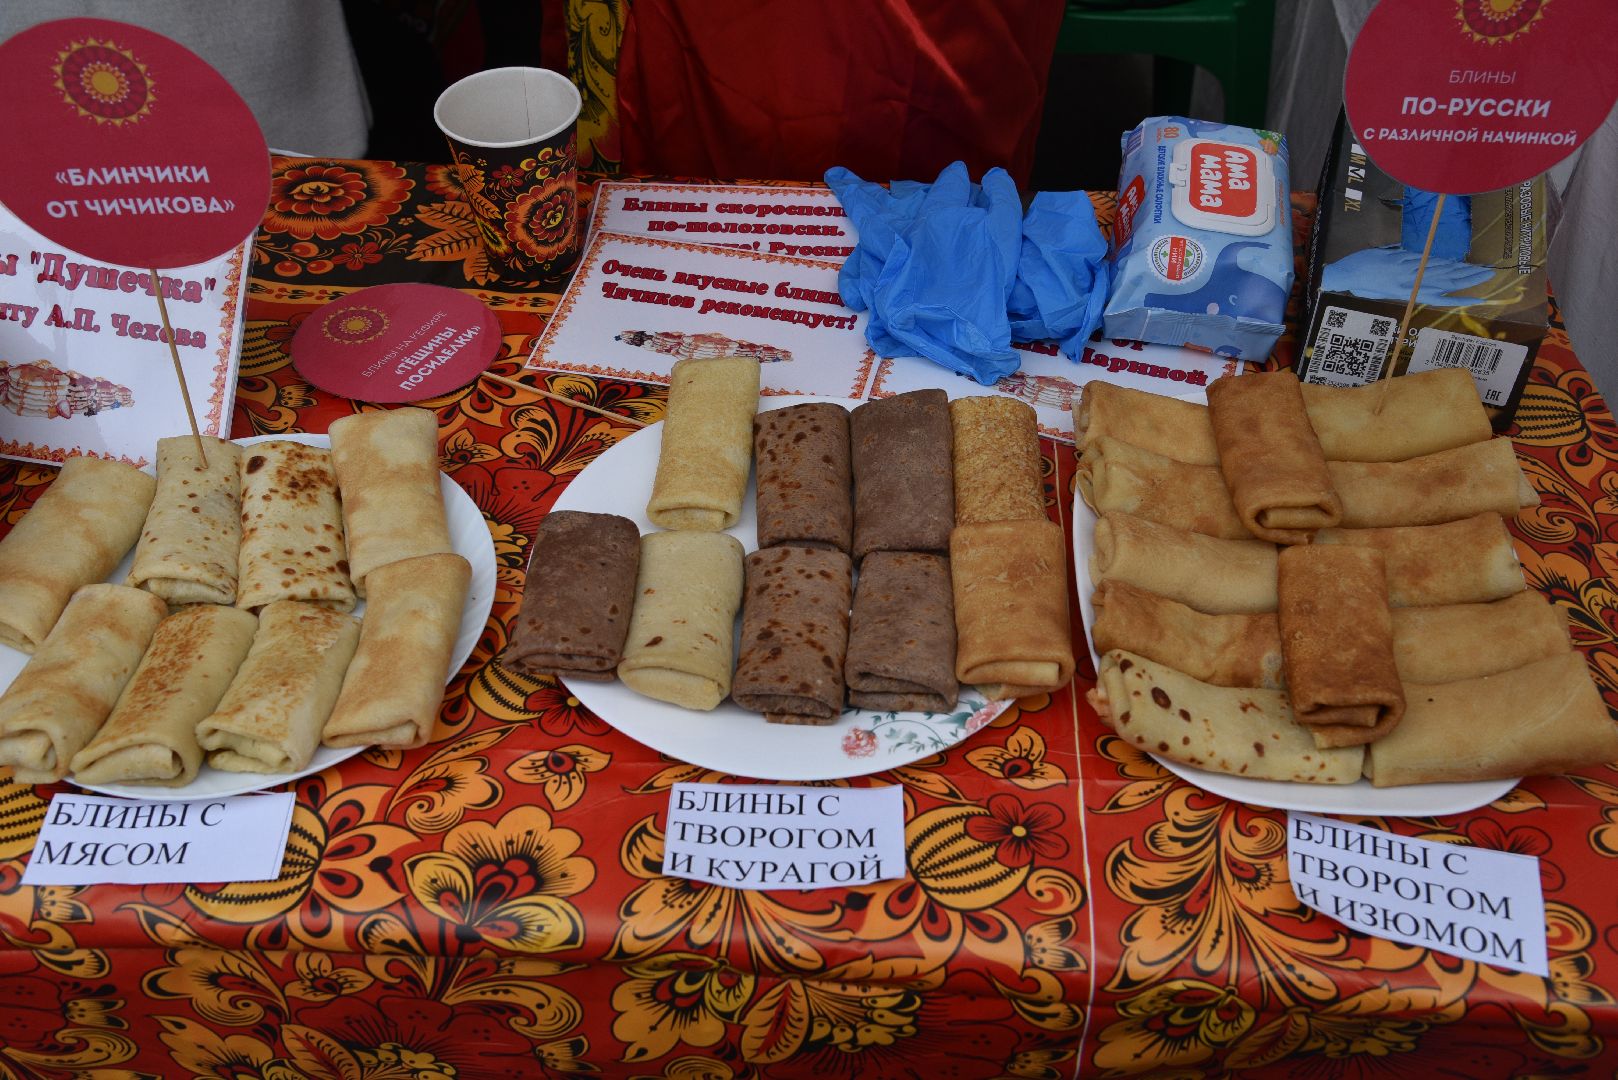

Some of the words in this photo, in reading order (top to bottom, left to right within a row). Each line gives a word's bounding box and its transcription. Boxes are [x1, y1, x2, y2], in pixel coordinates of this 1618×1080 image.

[1449, 70, 1516, 84] БЛИНЫ
[1401, 96, 1552, 118] ПО-РУССКИ
[1363, 128, 1376, 141] С
[1378, 128, 1479, 143] РАЗЛИЧНОЙ
[1481, 130, 1578, 146] НАЧИНКОЙ
[55, 165, 210, 188] «БЛИНЧИКИ
[47, 199, 80, 218] ОТ
[84, 196, 236, 217] ЧИЧИКОВА»
[622, 197, 709, 213] Блины
[647, 220, 846, 237] по-шолоховски.
[767, 240, 856, 257] Русски
[30, 250, 217, 304] "Душечка"
[602, 259, 668, 282] Очень
[672, 271, 770, 296] вкусные
[602, 281, 696, 309] Чичиков
[697, 298, 859, 330] рекомендует!
[44, 303, 101, 333] А.П.
[111, 313, 207, 350] Чехова
[361, 347, 398, 378] БЛИНЫ
[397, 339, 411, 352] НА
[399, 325, 481, 391] ПОСИДЕЛКИ»
[50, 801, 193, 829] БЛИНЫ
[200, 802, 226, 827] С
[676, 789, 807, 816] БЛИНЫ
[817, 795, 840, 816] С
[673, 820, 876, 850] ТВОРОГОМ
[1293, 819, 1431, 870] БЛИНЫ
[1443, 853, 1470, 876] С
[34, 840, 192, 866] МЯСОМ
[668, 852, 696, 874] И
[707, 854, 883, 884] КУРАГОЙ
[1293, 851, 1513, 921] ТВОРОГОМ
[1295, 881, 1320, 907] И
[1331, 894, 1528, 965] ИЗЮМОМ
